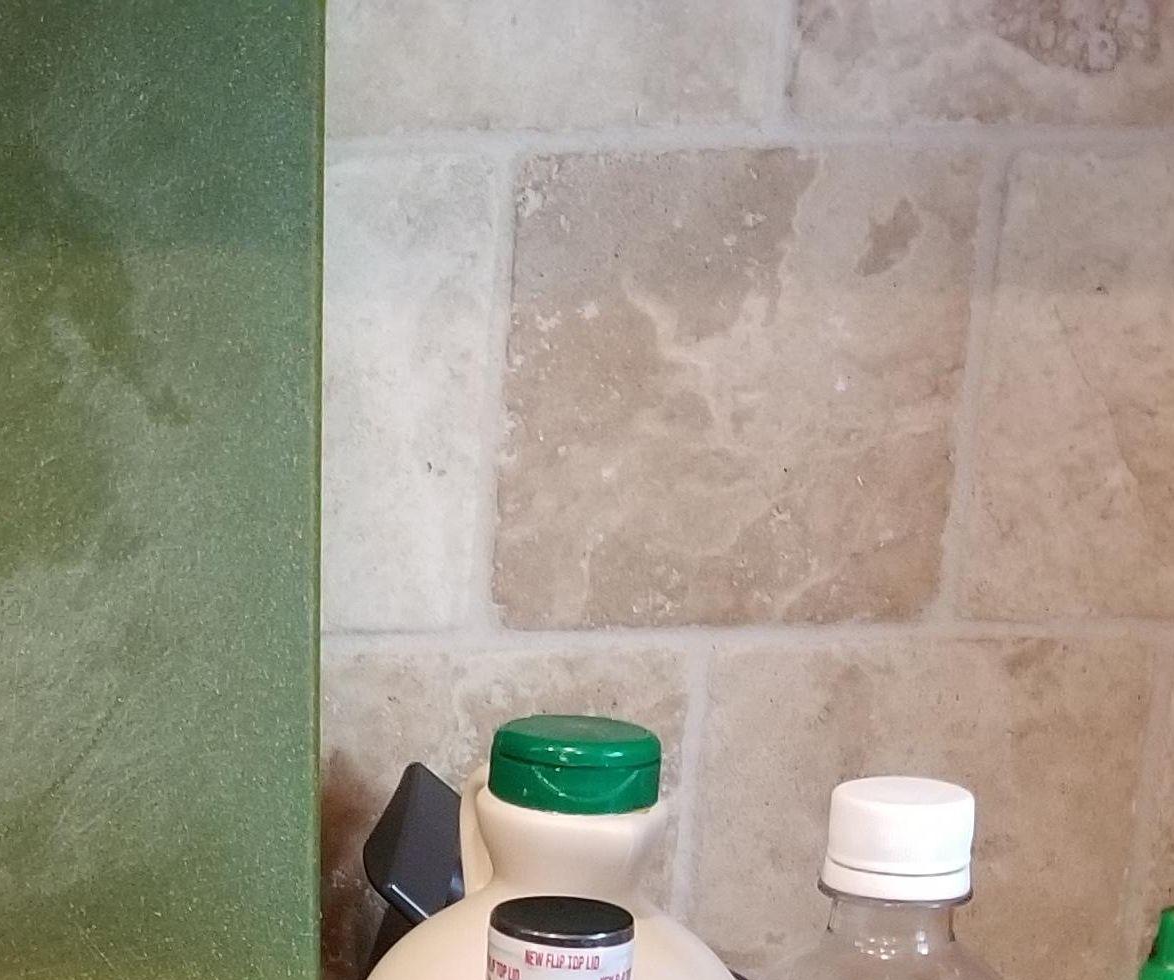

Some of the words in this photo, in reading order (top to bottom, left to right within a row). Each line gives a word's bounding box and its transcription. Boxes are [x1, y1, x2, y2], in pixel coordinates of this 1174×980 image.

[525, 950, 543, 967] NEW
[546, 953, 565, 969] FLIP
[568, 956, 584, 971] TOP
[587, 956, 600, 971] LID
